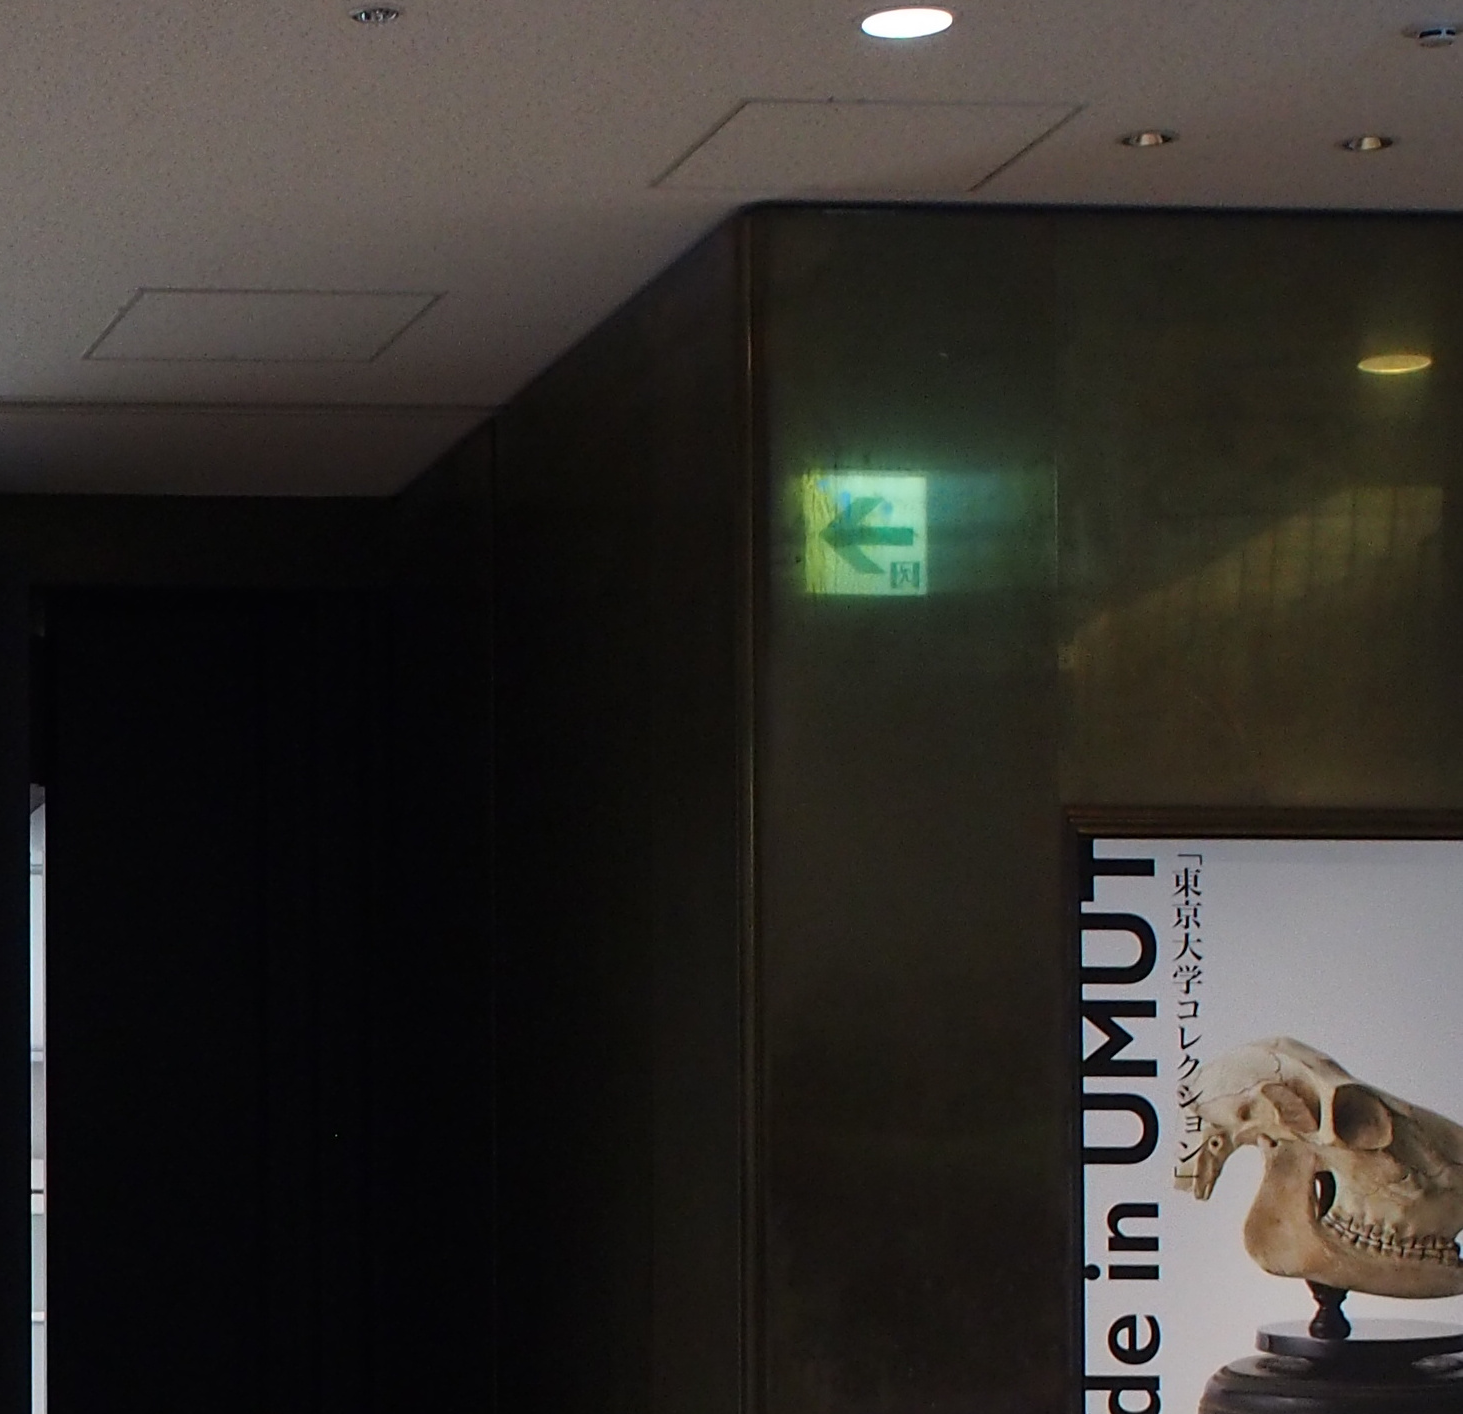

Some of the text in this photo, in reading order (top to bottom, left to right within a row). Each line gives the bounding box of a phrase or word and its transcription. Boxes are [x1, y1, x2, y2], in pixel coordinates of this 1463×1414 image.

[1079, 838, 1159, 1165] UMUT
[1174, 853, 1205, 1178] 「東京大学コレクション」
[1083, 1202, 1160, 1282] in
